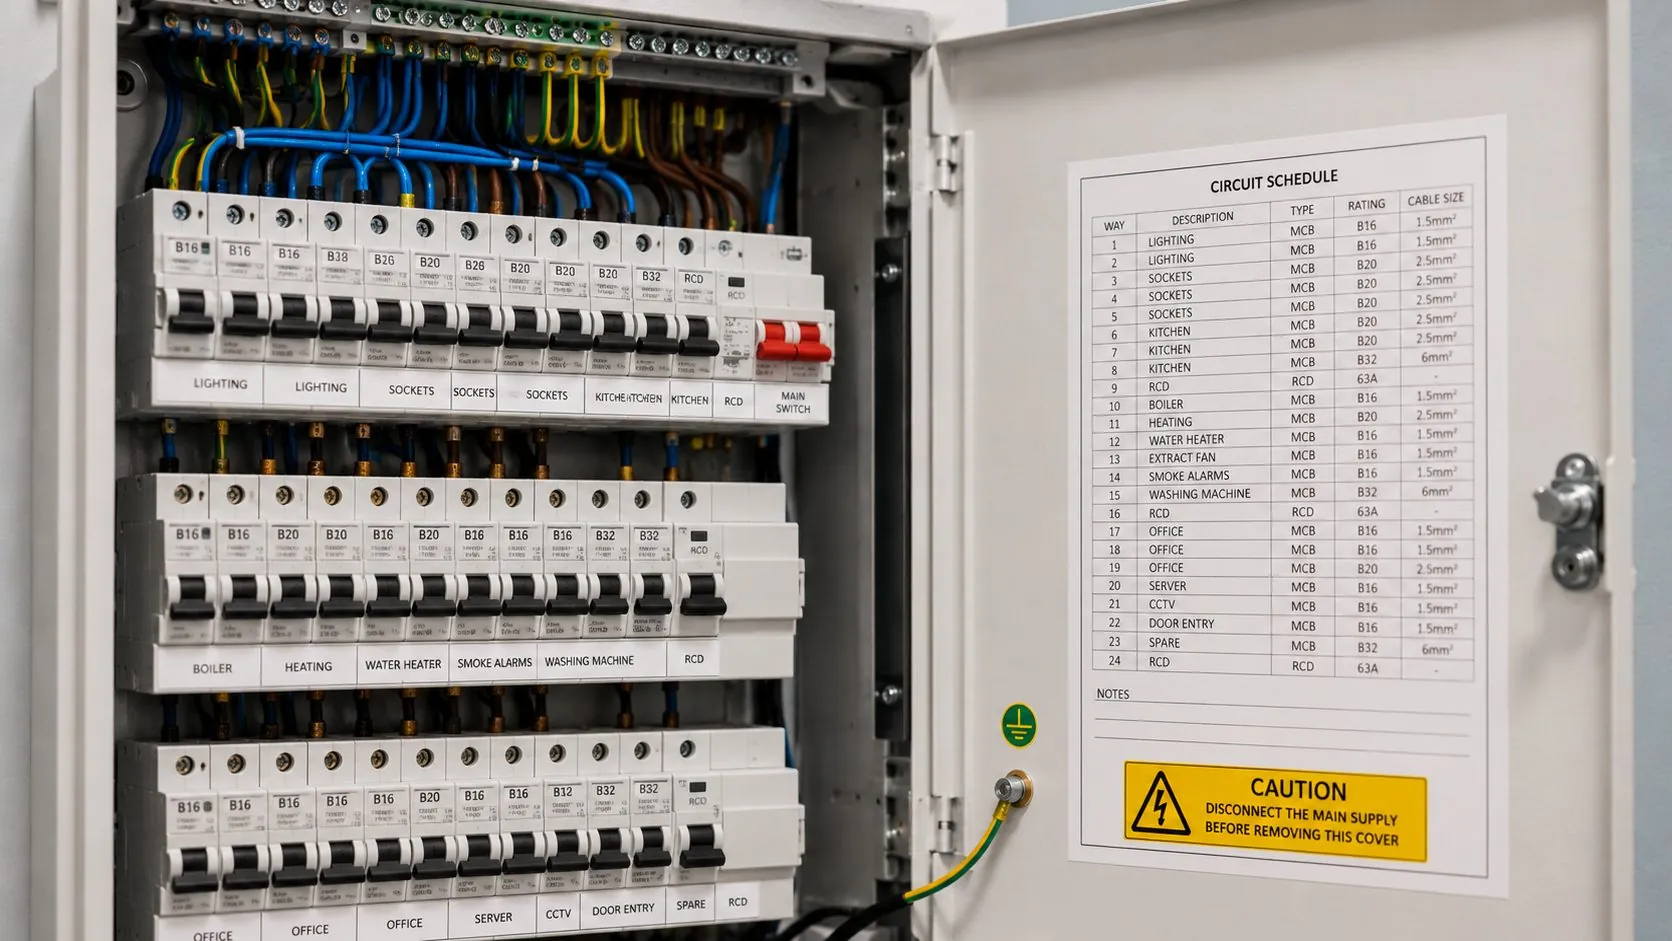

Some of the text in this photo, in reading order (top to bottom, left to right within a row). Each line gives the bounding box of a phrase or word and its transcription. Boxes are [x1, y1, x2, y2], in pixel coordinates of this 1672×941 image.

[1211, 169, 1338, 193] CIRCUIT SCHEDULE
[1104, 192, 1464, 231] WAY DESCRIPTION TYPE RATING CABLE SIZE
[1113, 240, 1116, 250] 1
[1149, 234, 1195, 248] LIGHTING
[1291, 225, 1314, 236] MCB
[1358, 220, 1376, 231] B16
[176, 241, 198, 253] B16
[229, 245, 251, 256] B16
[279, 248, 300, 259] B16
[1149, 252, 1194, 265] LIGHTING
[421, 257, 440, 268] B20
[511, 263, 530, 273] B20
[556, 266, 575, 276] B20
[599, 268, 617, 279] B20
[643, 271, 660, 281] B32
[1112, 276, 1117, 286] 3
[1149, 271, 1193, 285] SOCKETS
[1291, 263, 1315, 274] MCB
[1357, 259, 1377, 270] B20
[685, 274, 703, 283] RCD
[1149, 289, 1193, 303] SOCKETS
[1112, 301, 1315, 322] 5 SOCKETS MCB
[1149, 316, 1377, 337] KITCHEN B20
[1112, 344, 1190, 357] 7 KITCHEN
[1149, 363, 1190, 373] KITCHEN
[1291, 357, 1315, 367] MCB
[1358, 354, 1376, 365] B32
[194, 378, 247, 389] LIGHTING
[296, 382, 347, 393] LIGHTING
[1112, 376, 1314, 393] 9 RCD RCD
[389, 385, 434, 396] SOCKETS
[453, 387, 495, 399] SOCKETS
[526, 390, 568, 400] SOCKETS
[782, 392, 805, 400] MAIN
[671, 395, 708, 405] KITCHEN
[725, 397, 743, 406] RCD
[1149, 393, 1377, 410] BOILER B16
[776, 404, 810, 413] SWITCH
[1110, 413, 1315, 429] 11 HEATING MCB
[1149, 435, 1183, 446] WATER
[1187, 434, 1224, 444] HEATER
[1358, 430, 1377, 440] B16
[1110, 450, 1315, 464] 13 EXTRACT FAN MCB
[1149, 471, 1229, 481] SMOKE ALARMS
[1110, 487, 1377, 500] 15 WASHING MACHINE B32
[1150, 507, 1314, 518] RCD RCD
[177, 529, 199, 540] B16
[229, 529, 249, 540] B16
[278, 529, 299, 539] B20
[374, 529, 393, 540] B16
[465, 530, 484, 540] B16
[509, 530, 528, 540] B16
[554, 530, 572, 540] B16
[597, 530, 615, 540] B32
[640, 531, 659, 541] B32
[1110, 526, 1377, 536] 17 OFFICE B16
[1149, 545, 1315, 555] OFFICE MCB
[1110, 562, 1120, 572] 19
[1149, 563, 1183, 572] OFFICE
[1358, 564, 1378, 574] B20
[1149, 581, 1315, 592] SERVER MCB
[1109, 599, 1175, 609] 21 CCTV
[1149, 618, 1214, 628] DOOR ENTRY
[1109, 636, 1120, 646] 23
[1149, 637, 1180, 648] SPARE
[1292, 641, 1316, 651] MCB
[366, 659, 441, 670] WATER HEATER
[458, 658, 532, 668] SMOKE ALARMS
[545, 656, 634, 666] WASHING MACHINE
[685, 655, 704, 663] RCD
[1109, 656, 1378, 673] 24 RCD 63A
[193, 664, 232, 674] BOILER
[286, 662, 332, 672] HEATING
[1096, 688, 1130, 700] NOTES
[509, 789, 528, 799] B16
[597, 785, 615, 795] B32
[640, 784, 658, 793] B32
[1251, 778, 1346, 801] CAUTION
[327, 796, 347, 806] B16
[374, 794, 394, 804] B16
[420, 792, 440, 802] B20
[465, 790, 484, 801] B16
[178, 802, 200, 813] B16
[230, 800, 251, 810] B16
[279, 798, 299, 808] B16
[1206, 803, 1397, 826] DISCONNECT THE MAIN SUPPLY
[1206, 821, 1399, 846] BEFORE REMOVING THIS COVER
[677, 900, 705, 910] SPARE
[729, 897, 747, 906] RCD
[546, 909, 571, 919] CCTV
[593, 903, 654, 916] DOOR ENTRY
[475, 912, 512, 923] SERVER
[387, 918, 422, 929] OFFICE
[193, 931, 232, 941] OFFICE
[292, 925, 328, 936] OFFICE
